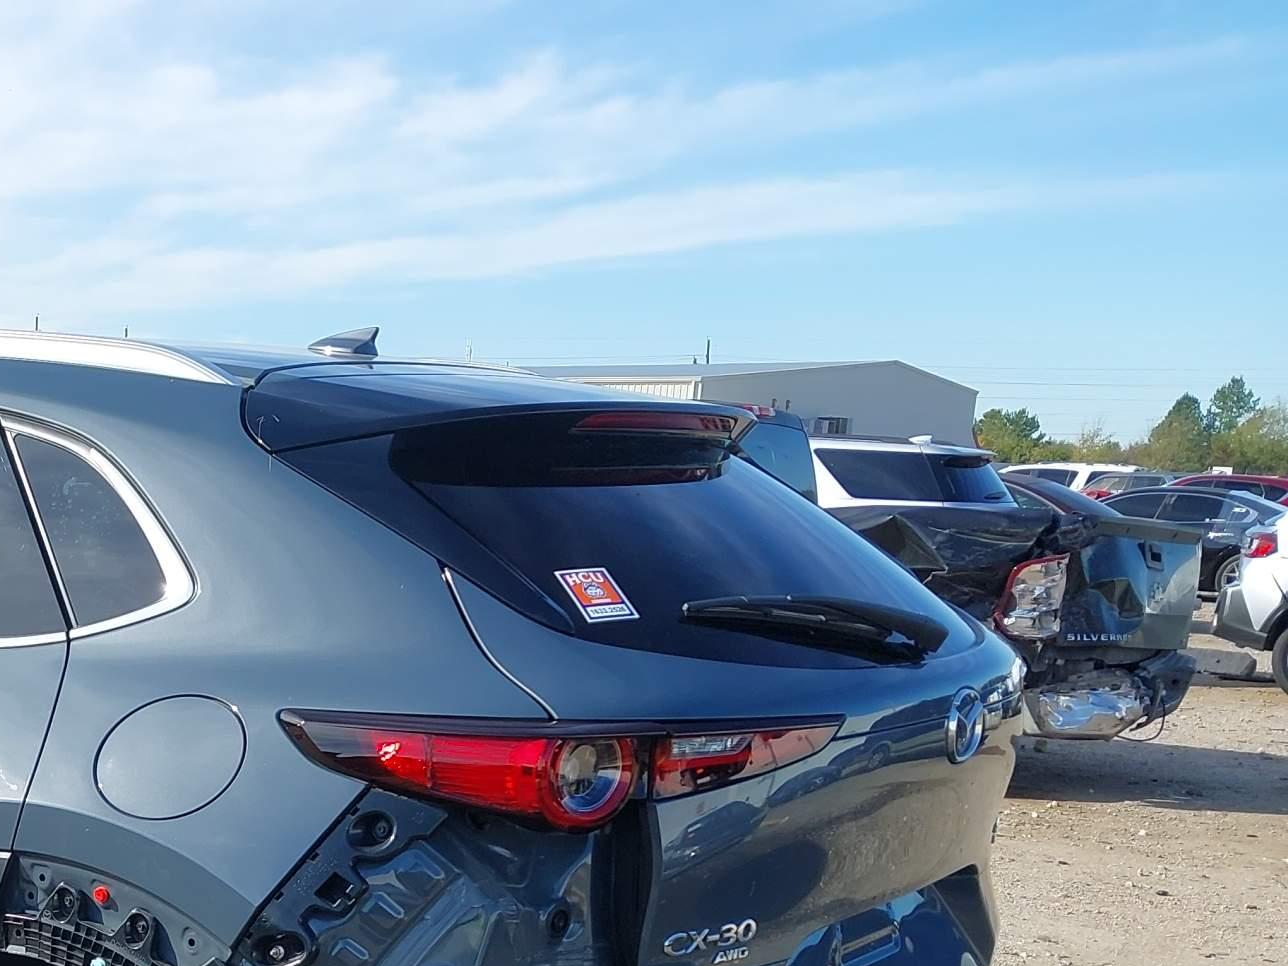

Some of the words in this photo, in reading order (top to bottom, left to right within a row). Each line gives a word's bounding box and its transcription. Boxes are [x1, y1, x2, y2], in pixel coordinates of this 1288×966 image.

[563, 572, 606, 587] HCU
[663, 917, 758, 957] CX-30
[712, 946, 750, 965] AWD
